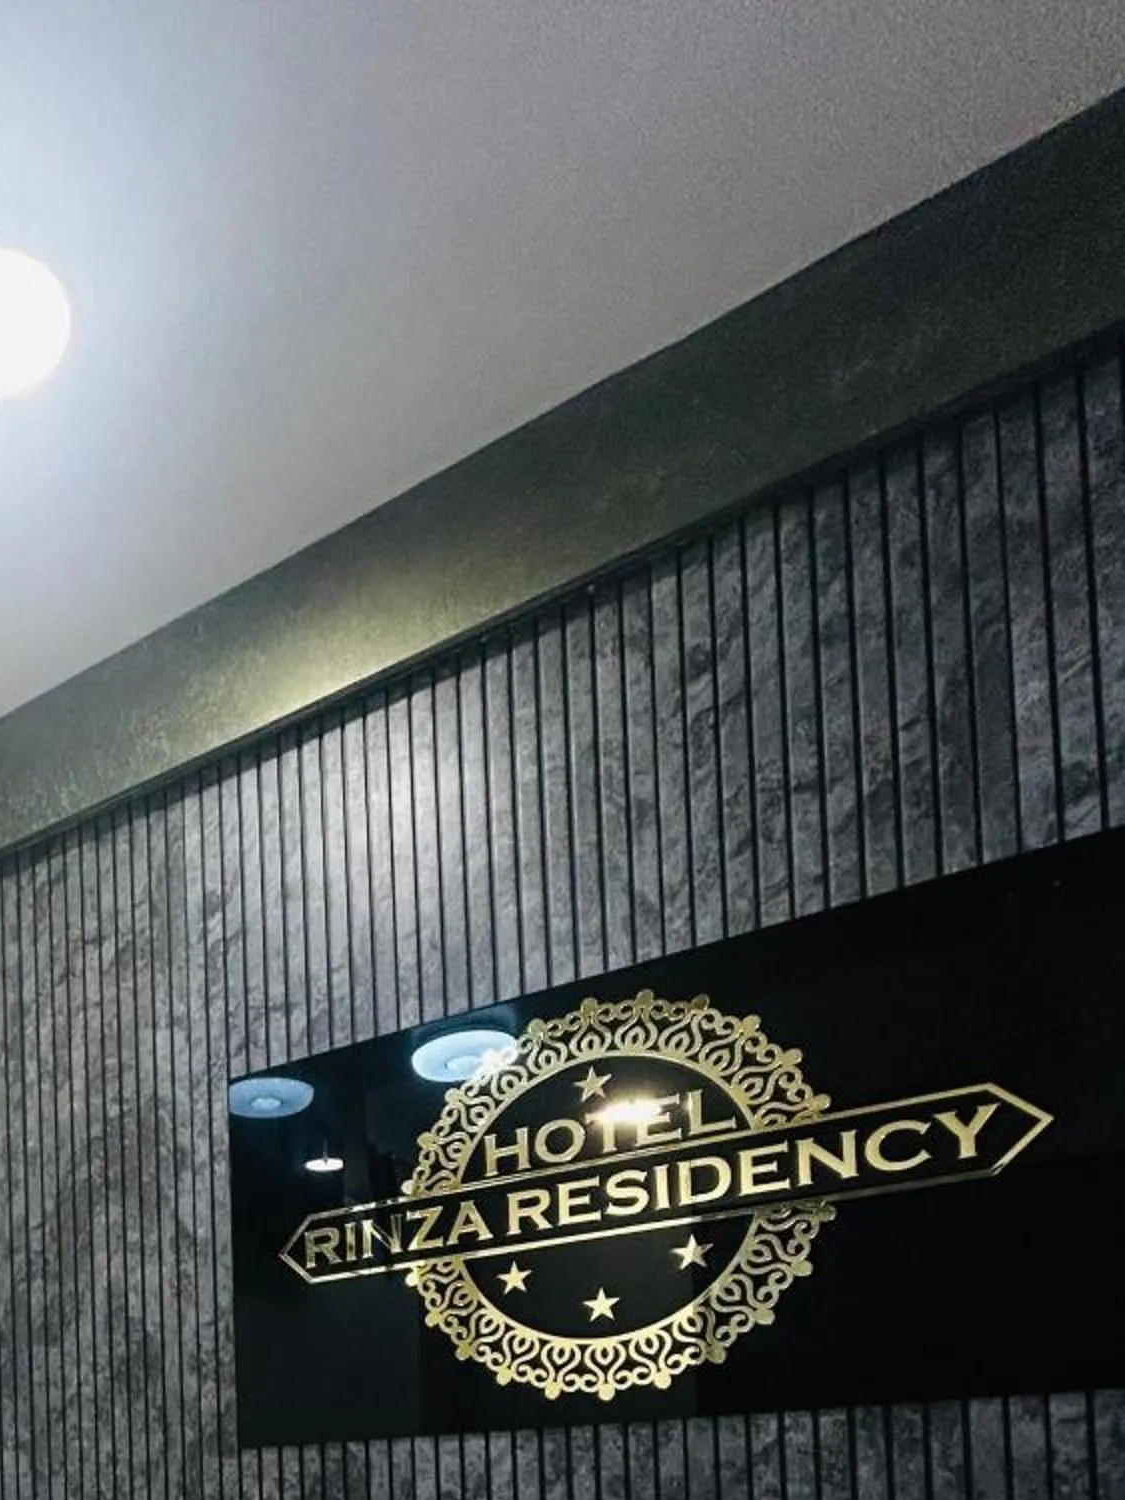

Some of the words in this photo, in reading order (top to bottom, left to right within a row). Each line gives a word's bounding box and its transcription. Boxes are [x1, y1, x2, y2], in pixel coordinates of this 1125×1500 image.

[303, 1200, 494, 1268] RINZA
[506, 1102, 1003, 1236] RESIDENCY
[483, 1089, 737, 1177] HOTEL
